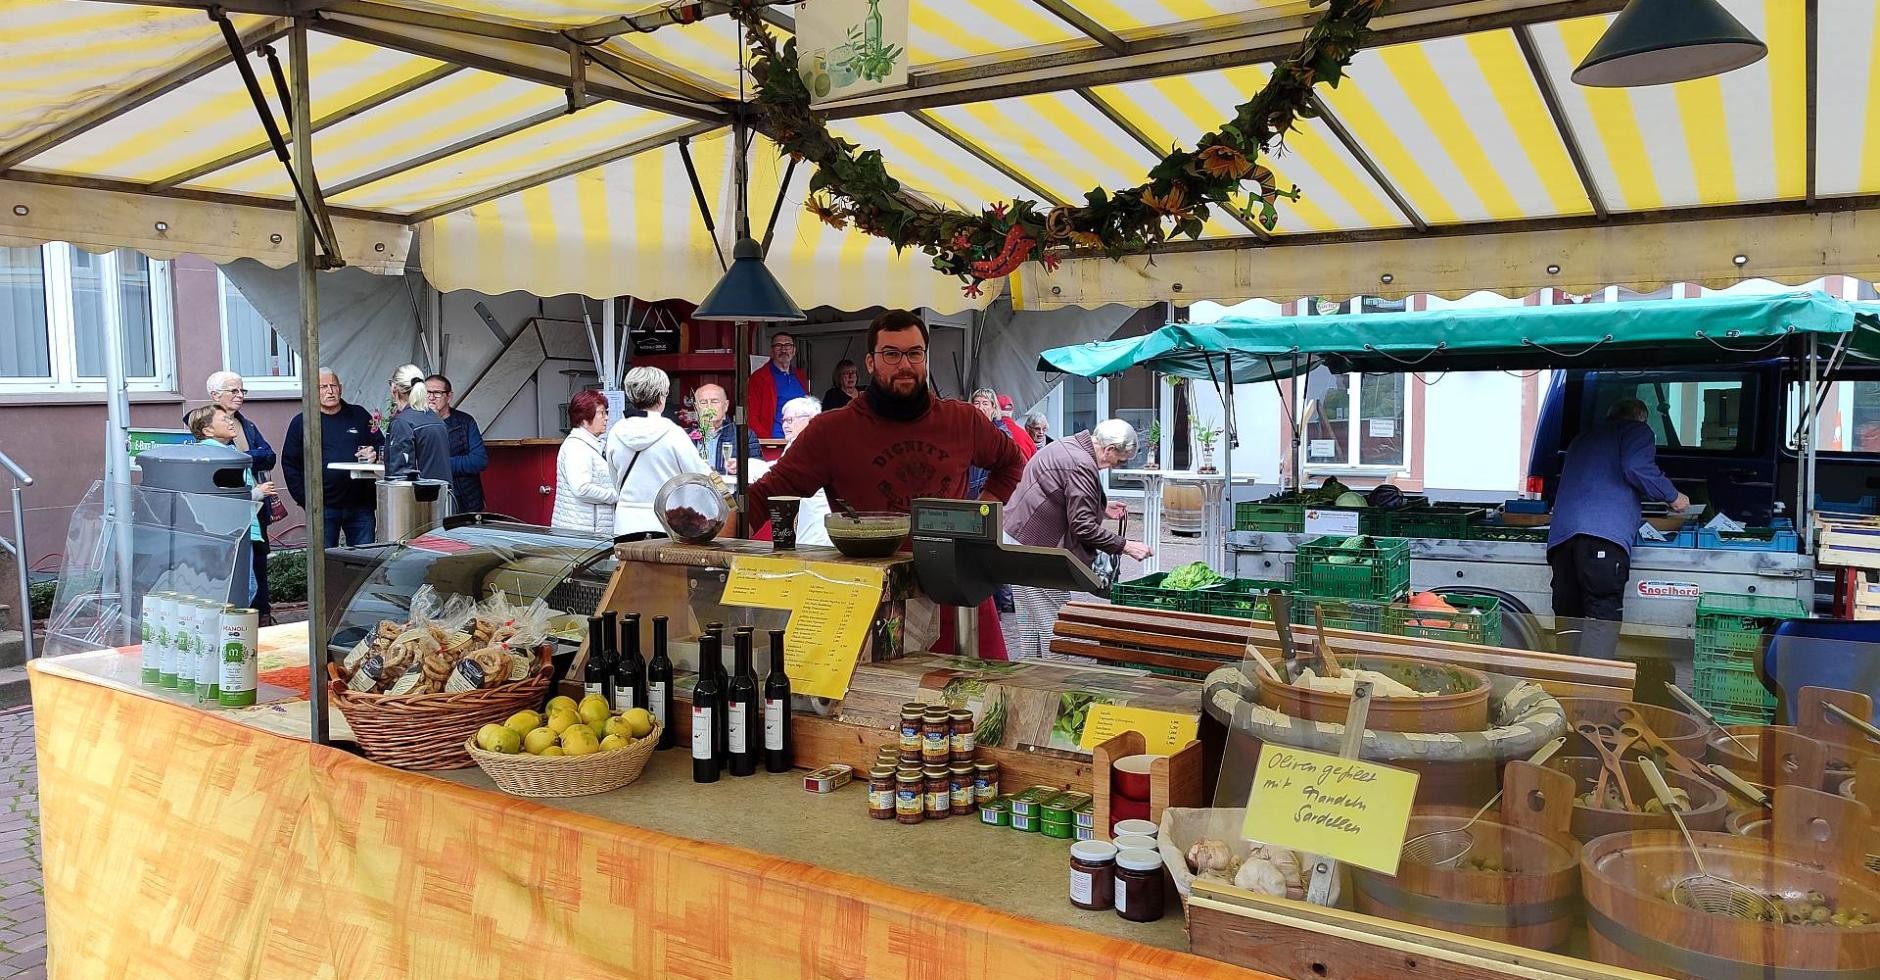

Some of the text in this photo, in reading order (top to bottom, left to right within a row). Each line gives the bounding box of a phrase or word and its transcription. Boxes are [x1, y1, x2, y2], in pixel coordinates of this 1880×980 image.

[872, 440, 950, 467] DIGNITY
[1638, 582, 1698, 595] Engelhard
[1268, 752, 1376, 786] Oliven gefüllt
[1263, 778, 1367, 810] mit Mandeln
[1294, 804, 1361, 834] Sardellen
